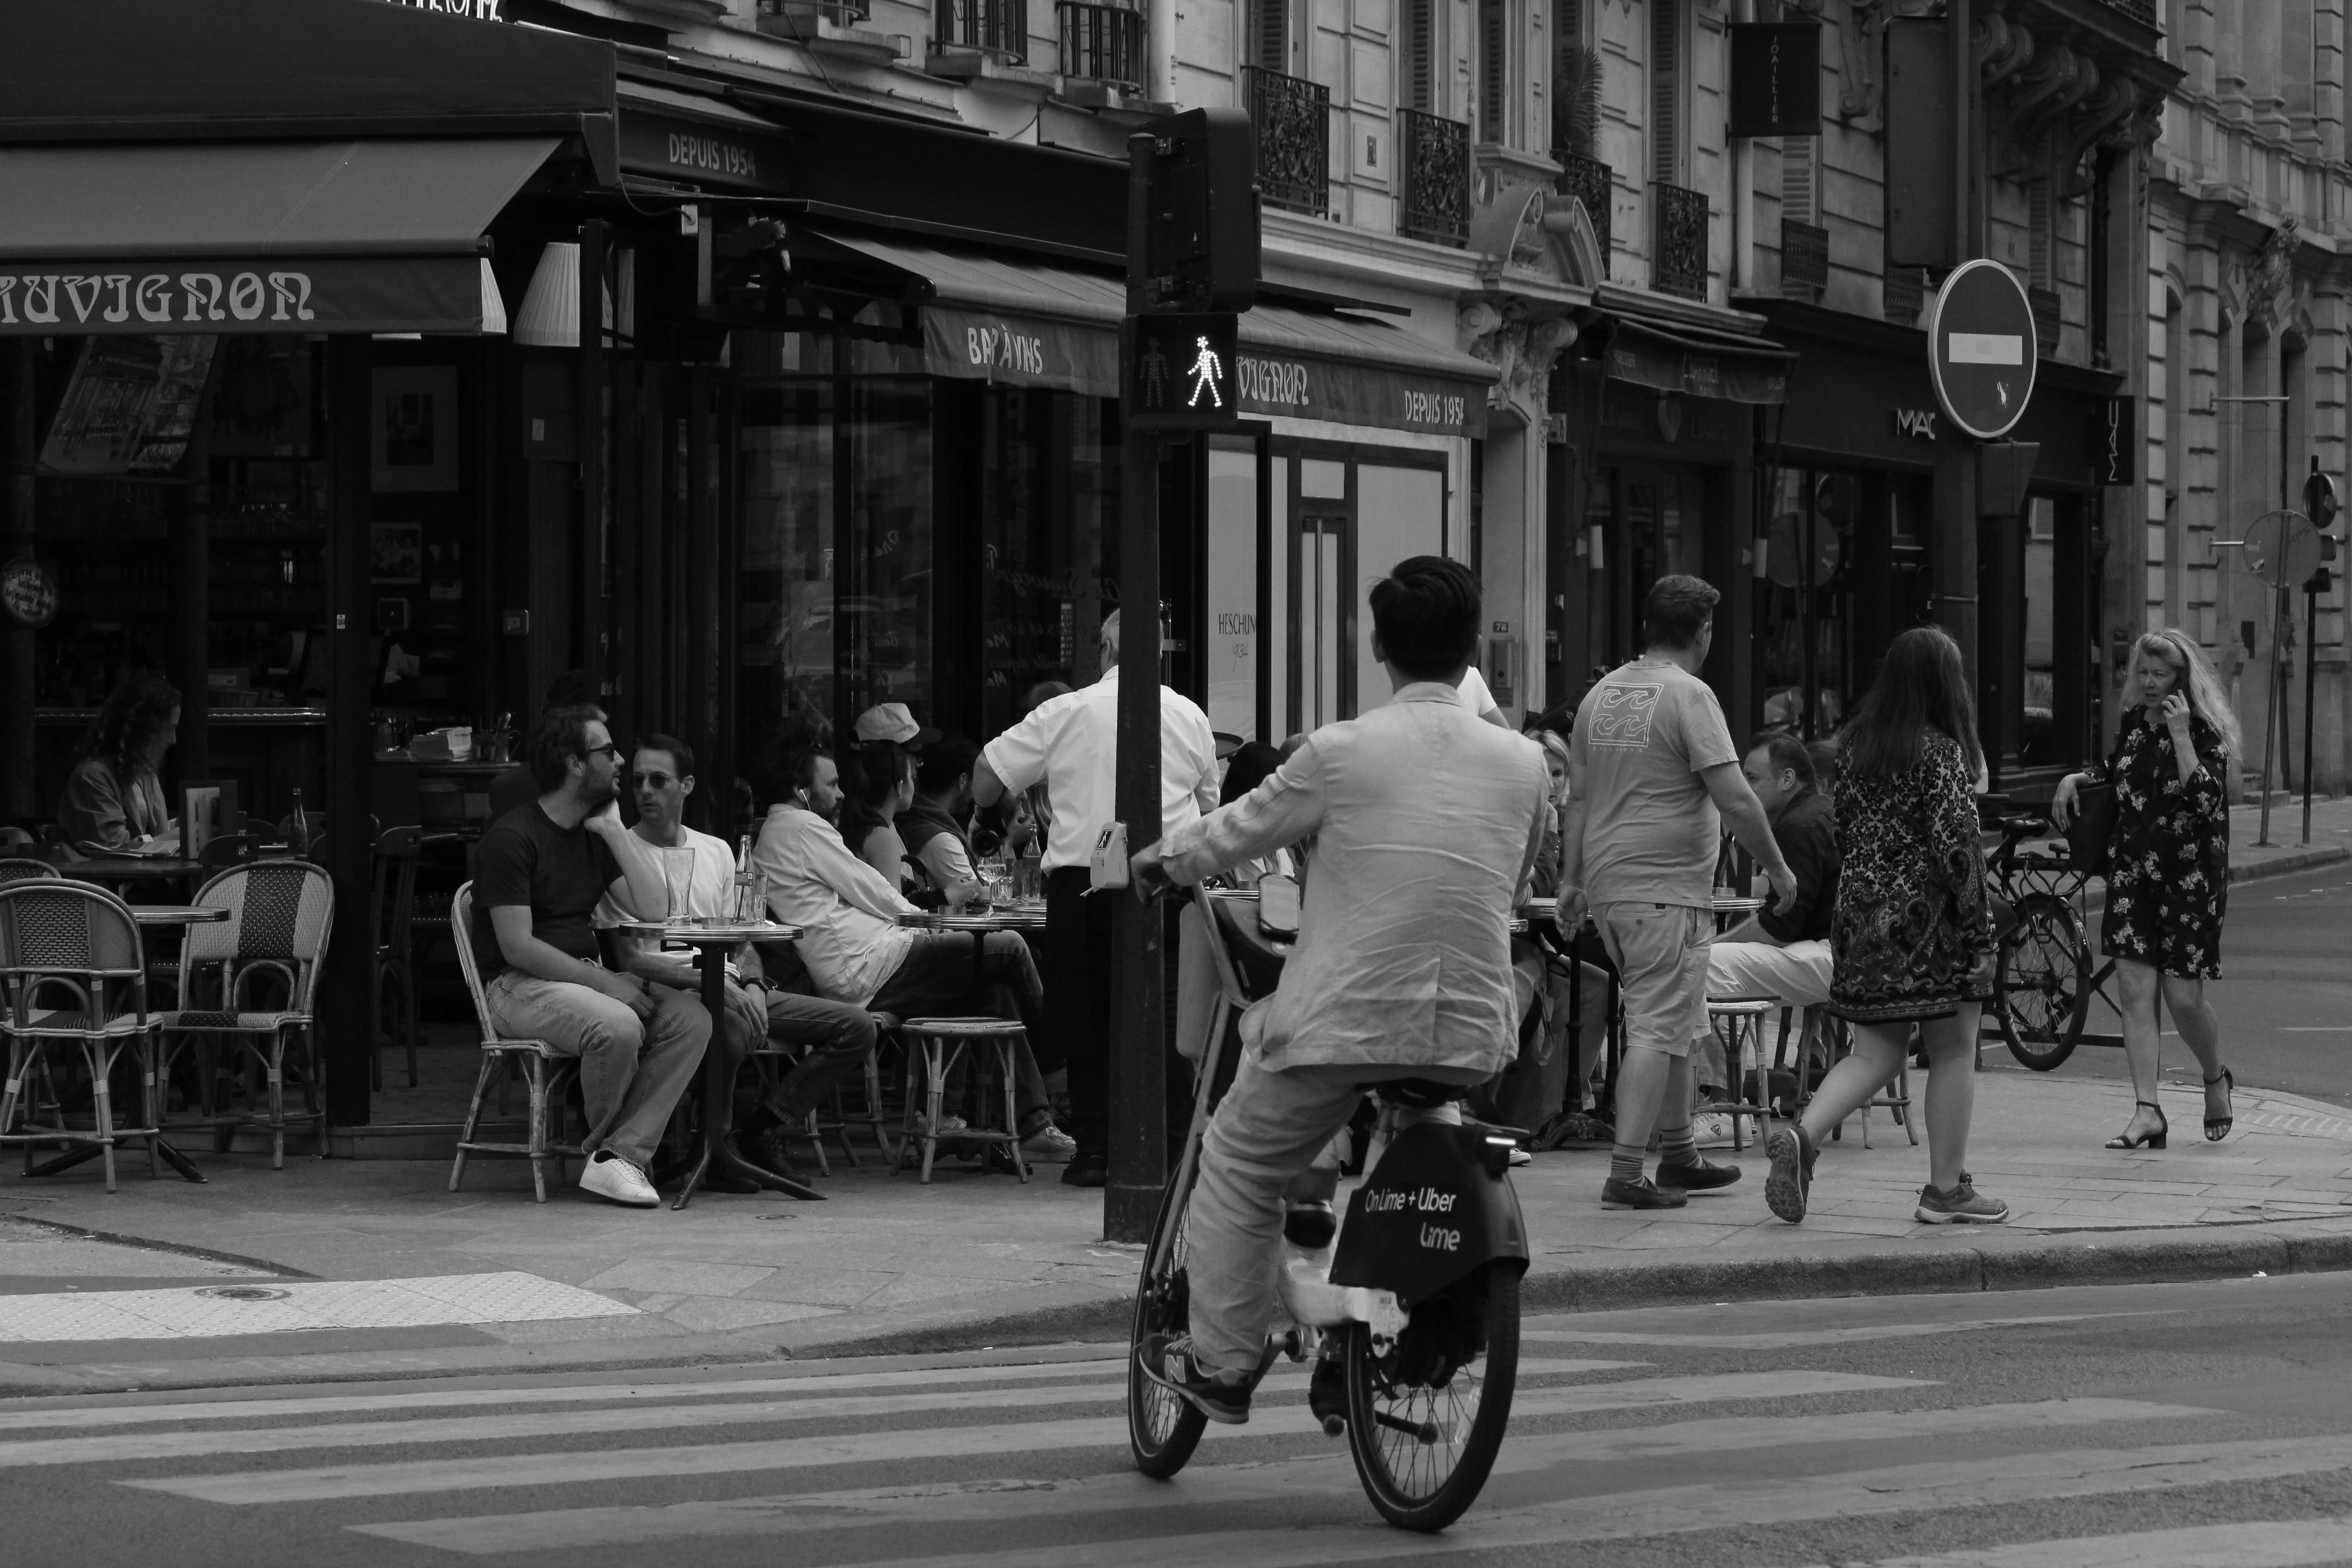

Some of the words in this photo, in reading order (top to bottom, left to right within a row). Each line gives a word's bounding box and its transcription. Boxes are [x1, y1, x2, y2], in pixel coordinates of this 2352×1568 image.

[669, 133, 720, 171] DEPUIS
[722, 144, 756, 177] 1954
[1012, 334, 1043, 374] VINS
[1405, 390, 1441, 424] DEPUIS
[1897, 408, 1936, 440] MAC
[1496, 622, 1507, 632] 78
[1418, 1187, 1457, 1212] Uber
[1420, 1222, 1460, 1251] Lime
